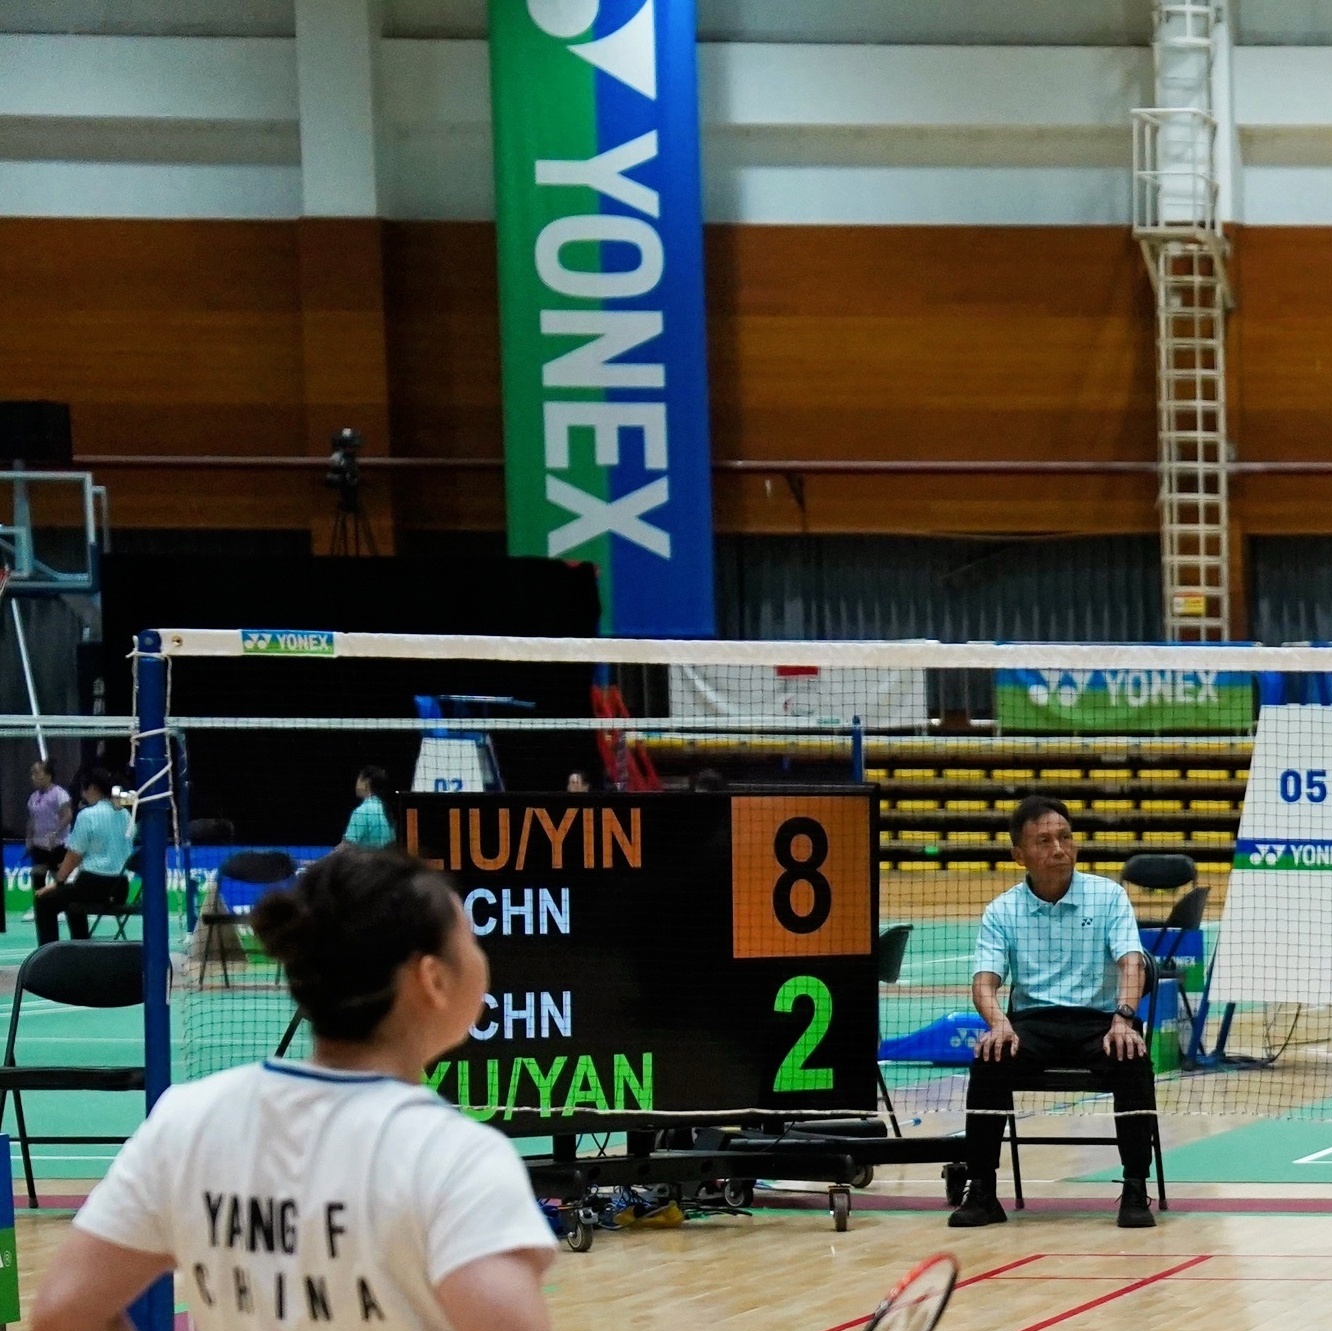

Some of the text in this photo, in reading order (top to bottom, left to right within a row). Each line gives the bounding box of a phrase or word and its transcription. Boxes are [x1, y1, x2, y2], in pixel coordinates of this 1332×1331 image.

[534, 129, 671, 559] YONEX
[276, 633, 329, 651] YONEX
[1102, 669, 1219, 707] YONEX
[1280, 768, 1327, 803] 05
[406, 807, 641, 871] LIU/YIN
[772, 816, 832, 935] 8
[464, 888, 570, 935] CHN
[468, 991, 571, 1041] CHN
[773, 975, 833, 1092] 2
[203, 1191, 347, 1259] YANG F
[193, 1263, 386, 1323] CHINA
